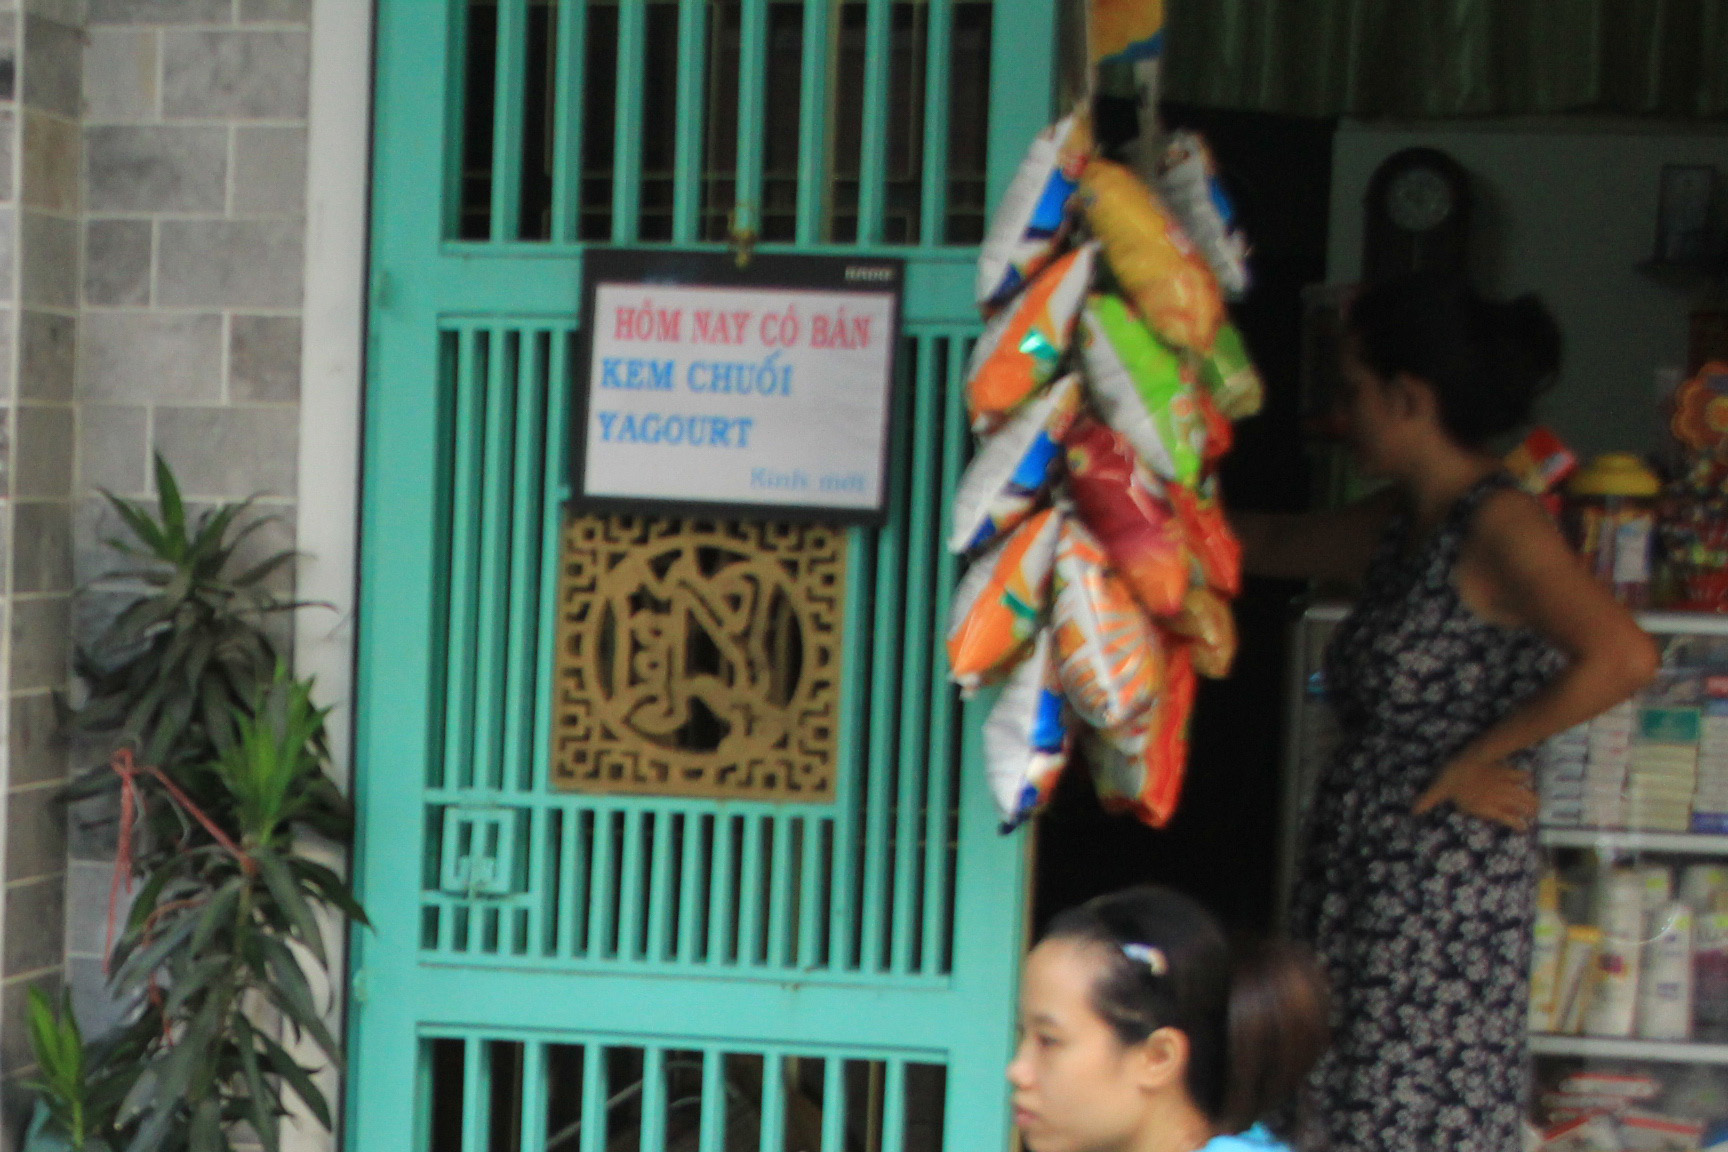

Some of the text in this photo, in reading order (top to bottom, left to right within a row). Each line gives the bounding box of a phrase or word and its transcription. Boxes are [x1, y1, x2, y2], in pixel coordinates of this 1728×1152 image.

[614, 299, 872, 350] HÔM NAY CÓ BÁN
[601, 350, 794, 396] KEM CHUỐI
[598, 411, 754, 448] YAGOURT
